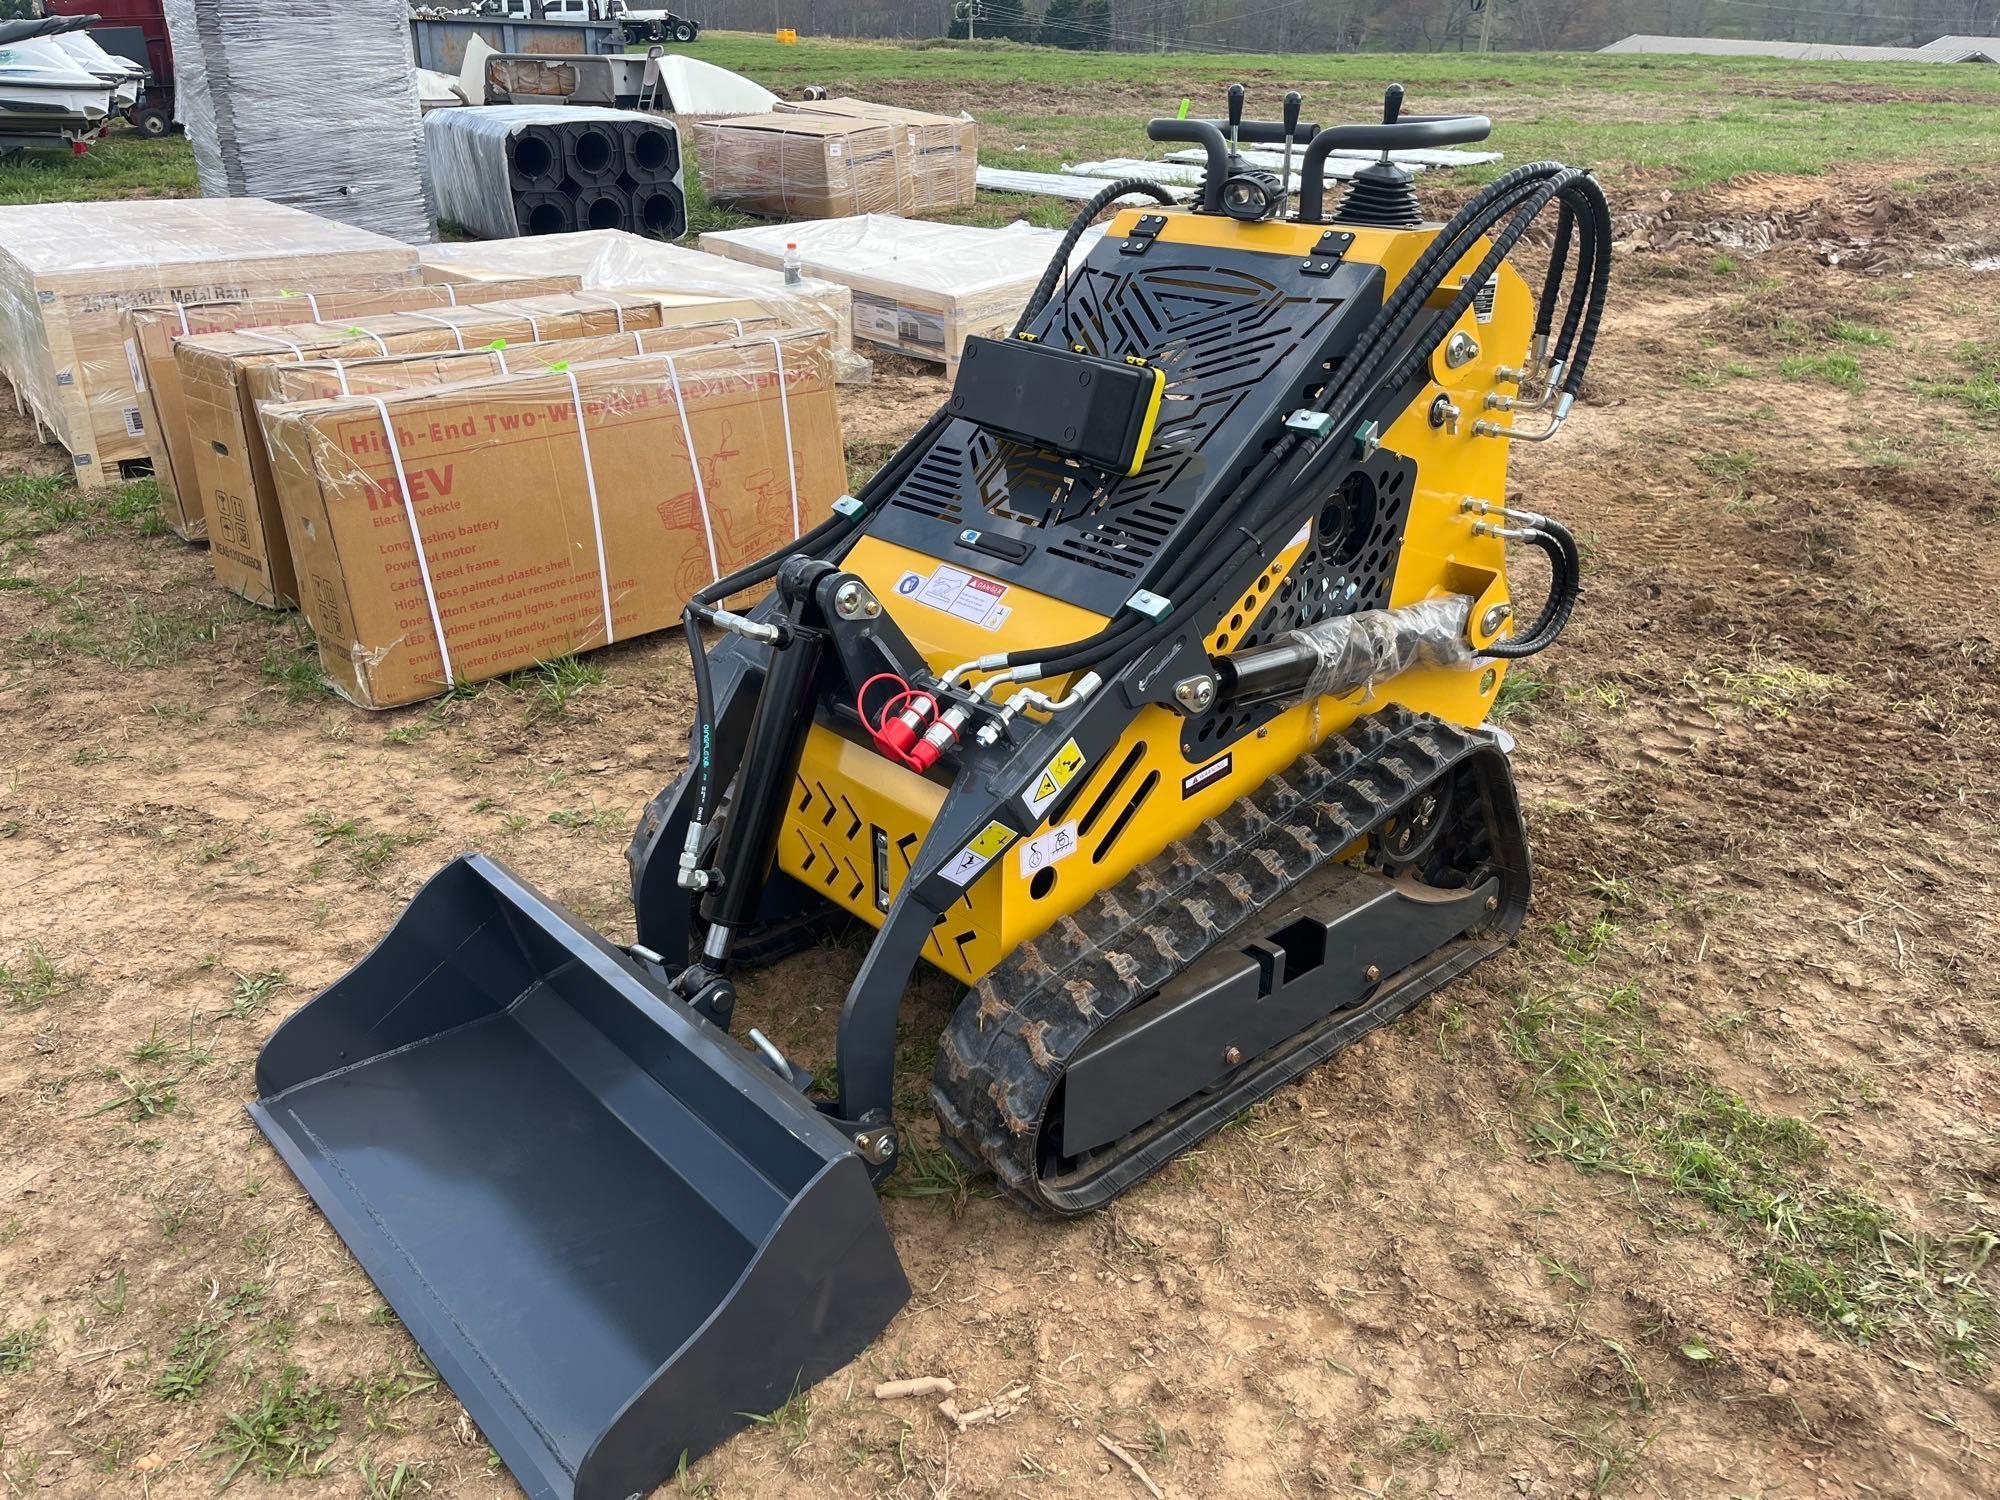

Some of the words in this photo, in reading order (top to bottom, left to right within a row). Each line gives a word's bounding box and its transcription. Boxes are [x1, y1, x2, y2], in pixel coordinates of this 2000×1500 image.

[215, 286, 250, 300] Barn
[363, 464, 454, 511] IREV
[419, 500, 461, 518] vehicle
[379, 528, 456, 554] Long-asting
[458, 520, 500, 536] battery
[741, 537, 761, 556] IREV
[385, 553, 440, 574] Poweul
[442, 544, 477, 560] motor
[436, 563, 464, 581] steel
[466, 558, 500, 574] frame
[394, 588, 459, 611] High-loss
[461, 575, 504, 597] painted
[507, 564, 542, 584] plastic
[545, 558, 570, 573] shell
[470, 597, 499, 611] start,
[501, 585, 526, 602] dual
[528, 578, 567, 595] remote
[977, 582, 1003, 594] DANGER
[404, 635, 425, 648] LED
[429, 623, 476, 641] dytime
[479, 610, 522, 627] running
[523, 600, 558, 616] lights,
[504, 620, 550, 639] friendly,
[552, 612, 577, 625] long
[491, 643, 535, 662] display,
